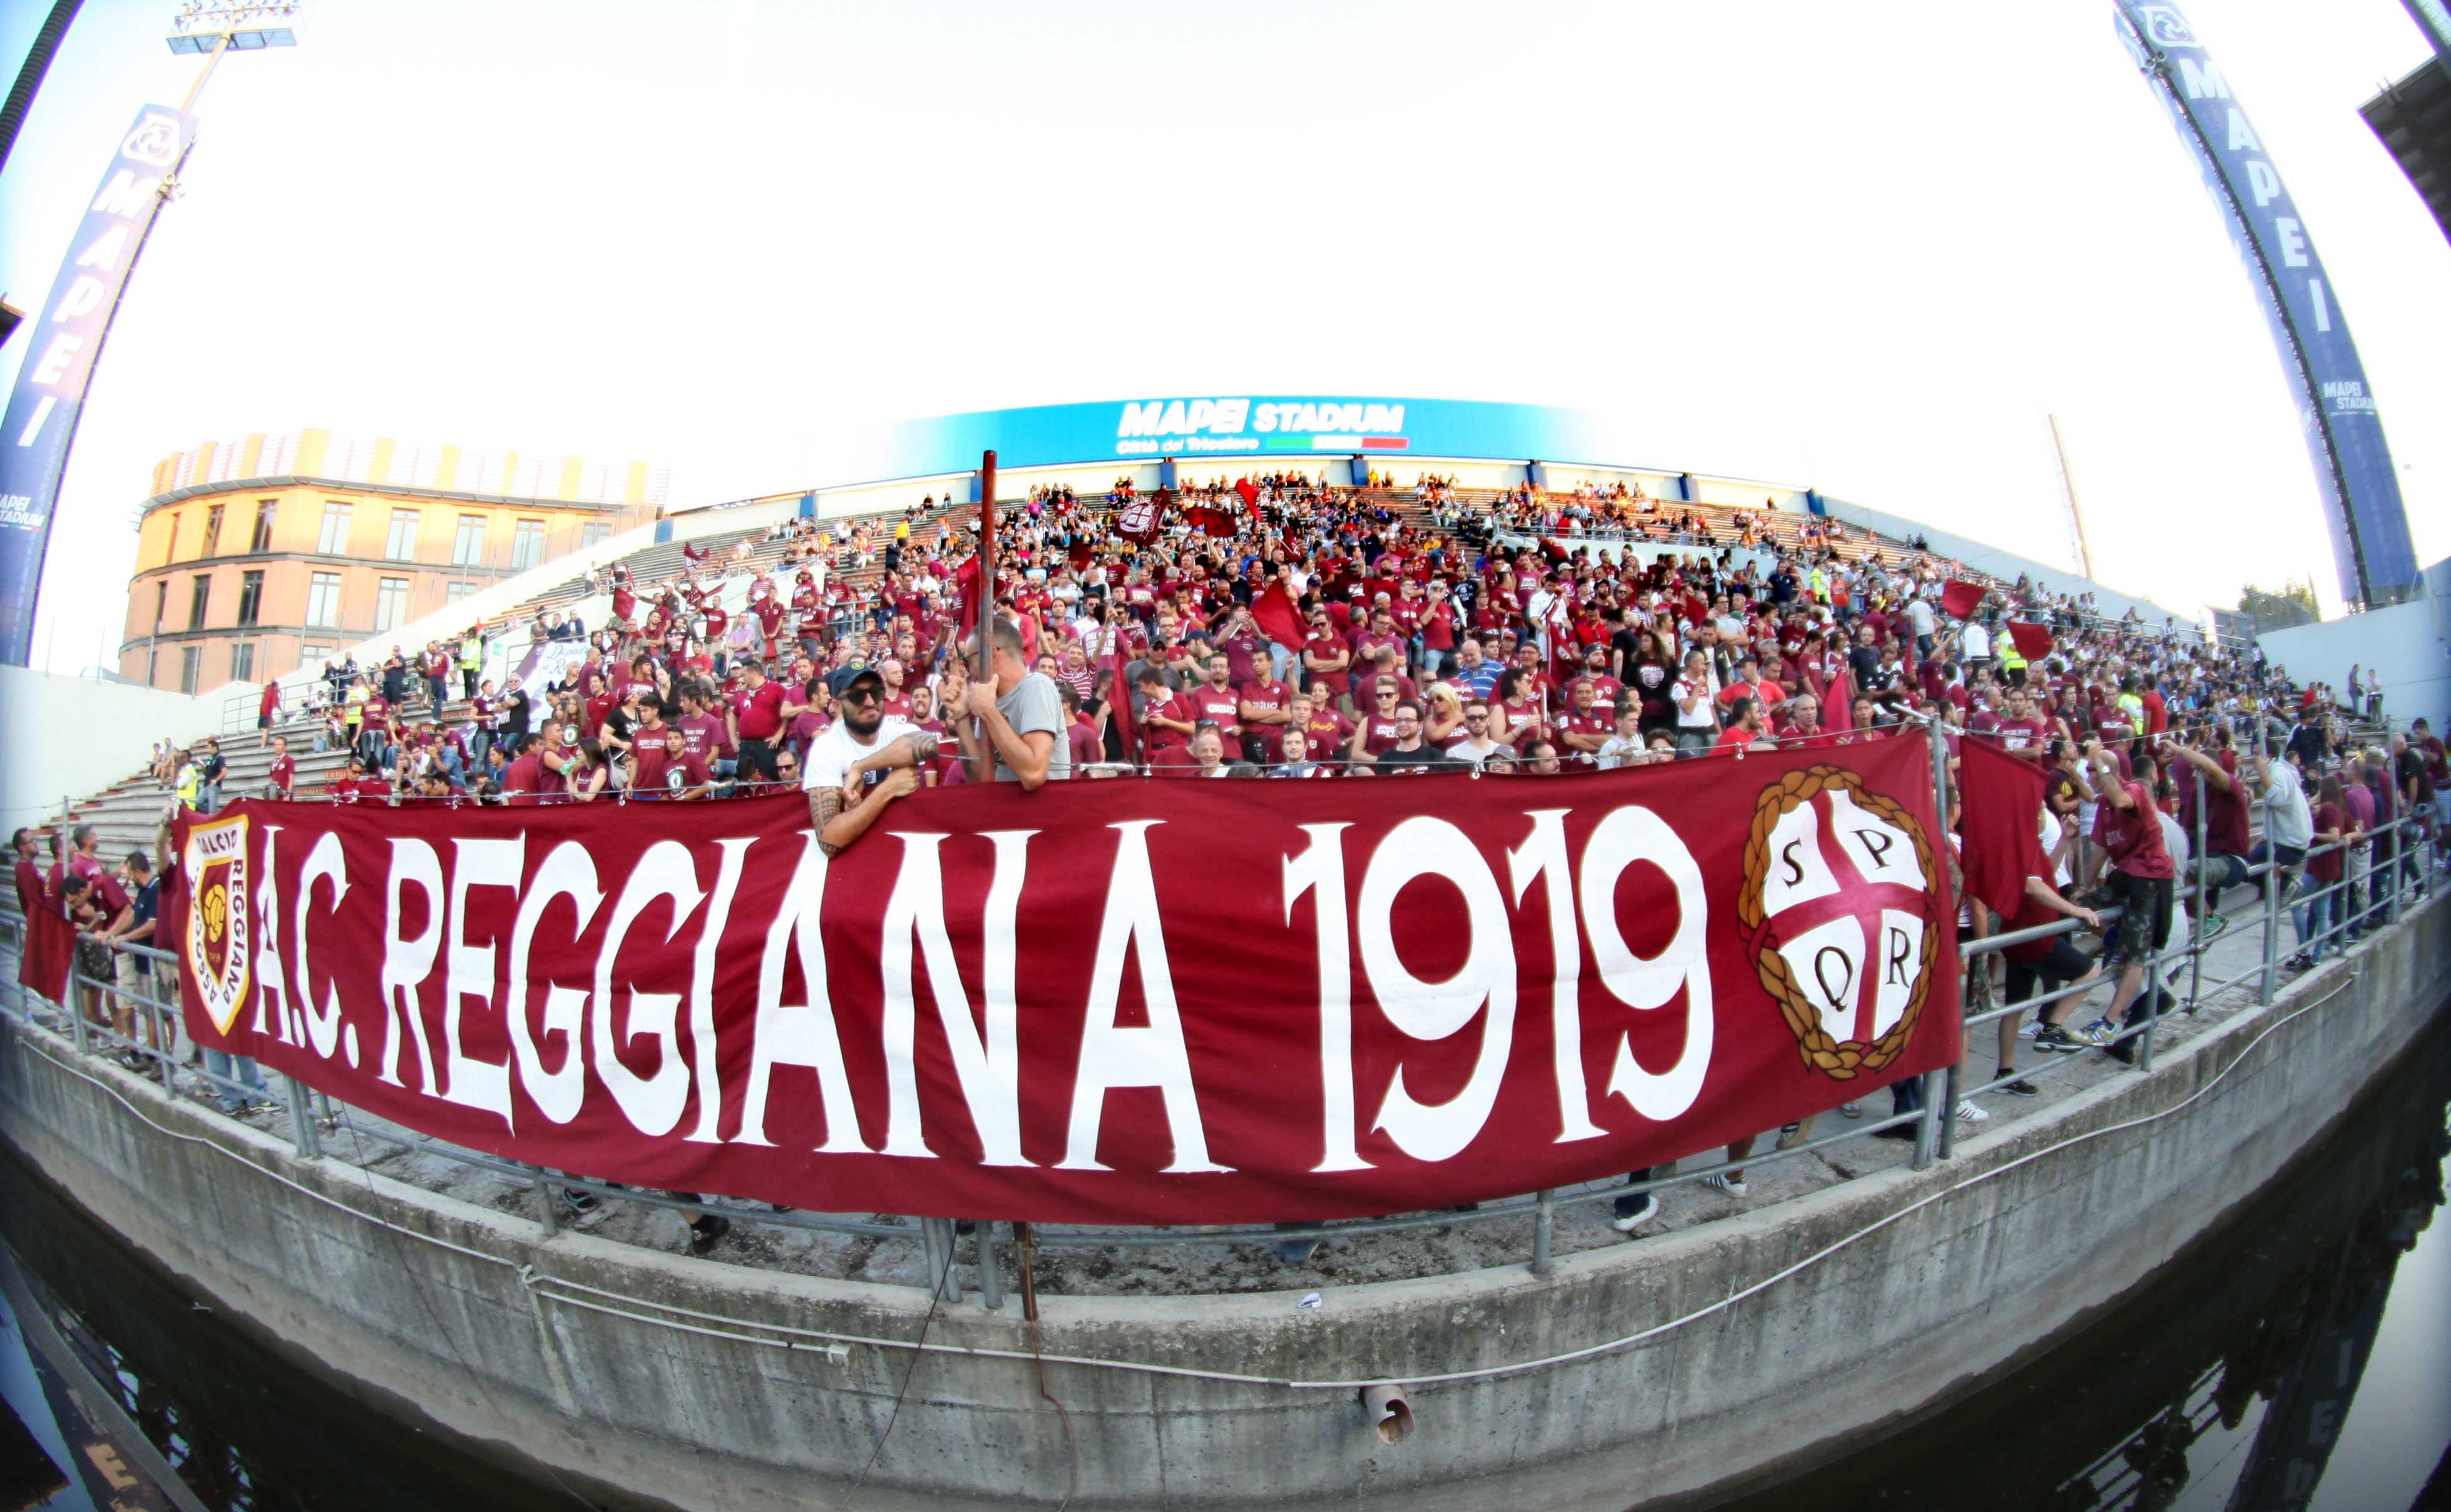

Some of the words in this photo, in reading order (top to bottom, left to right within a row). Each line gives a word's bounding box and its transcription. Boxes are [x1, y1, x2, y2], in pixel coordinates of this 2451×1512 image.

[2179, 59, 2330, 332] MAPEI
[18, 170, 155, 447] MAPEI
[2323, 382, 2361, 397] MAPEI
[1117, 398, 1251, 437] MAPEI
[1254, 402, 1405, 433] STADIUM
[1162, 439, 1184, 452] del
[0, 494, 31, 511] APEI
[0, 509, 46, 527] TADIUM
[1207, 703, 1236, 715] GIGLIO
[223, 859, 245, 1005] REGGIANA
[252, 825, 359, 1069] A.C.
[376, 819, 1239, 1173] REGGIANA
[1283, 805, 1714, 1173] 1919
